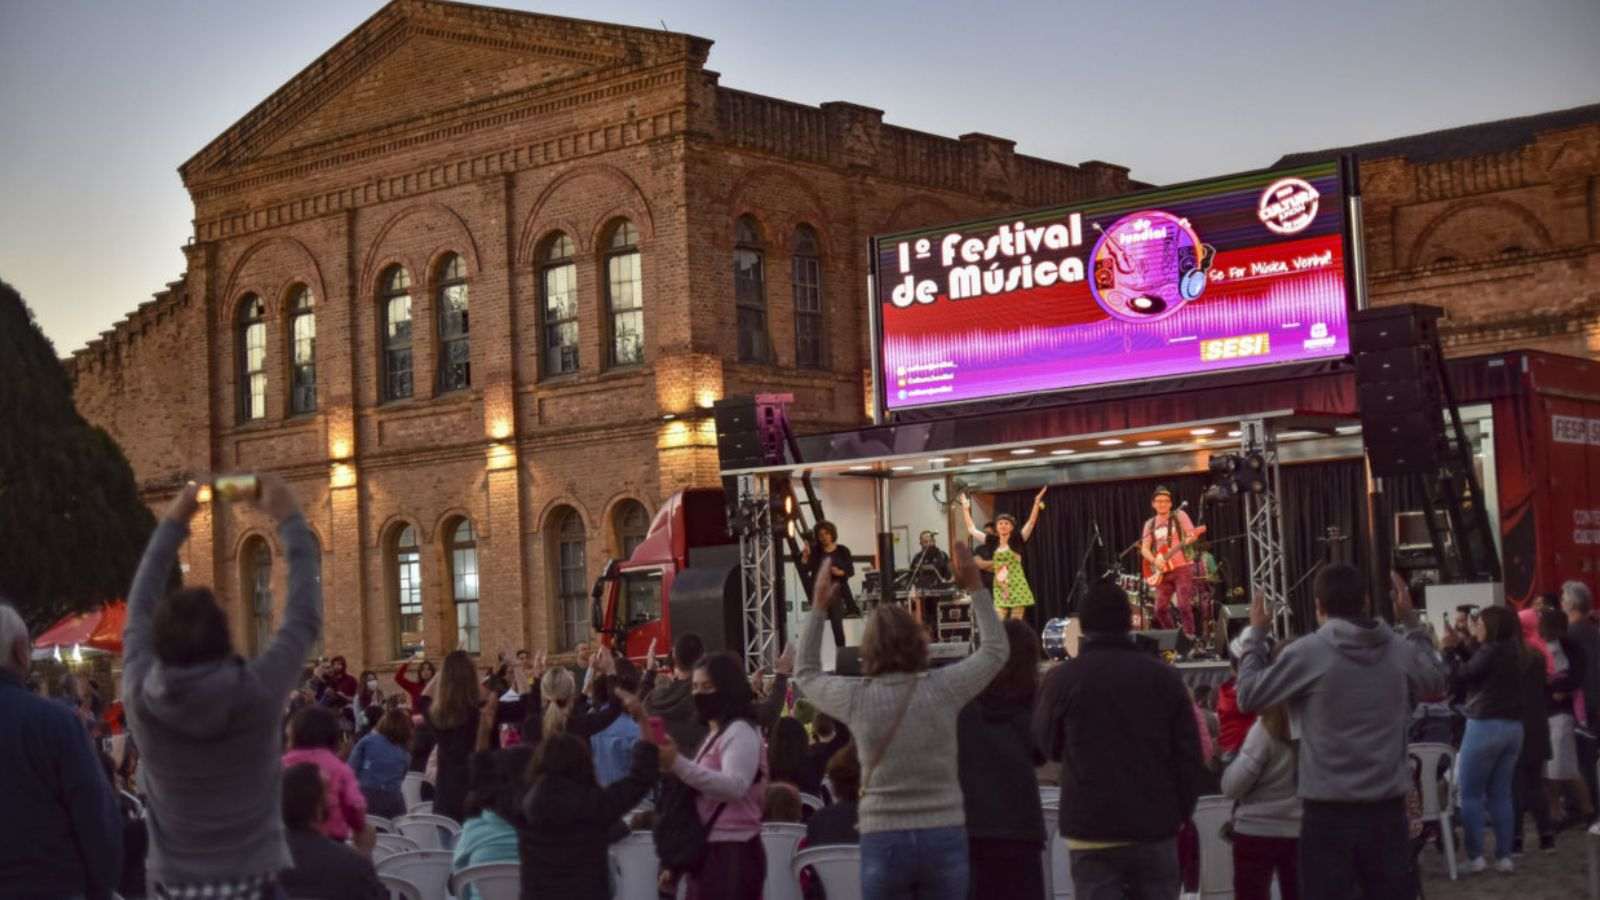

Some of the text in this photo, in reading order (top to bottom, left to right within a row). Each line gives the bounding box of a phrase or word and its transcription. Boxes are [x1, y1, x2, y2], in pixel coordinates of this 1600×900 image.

[891, 255, 1085, 308] de Música
[1206, 335, 1264, 360] SESI
